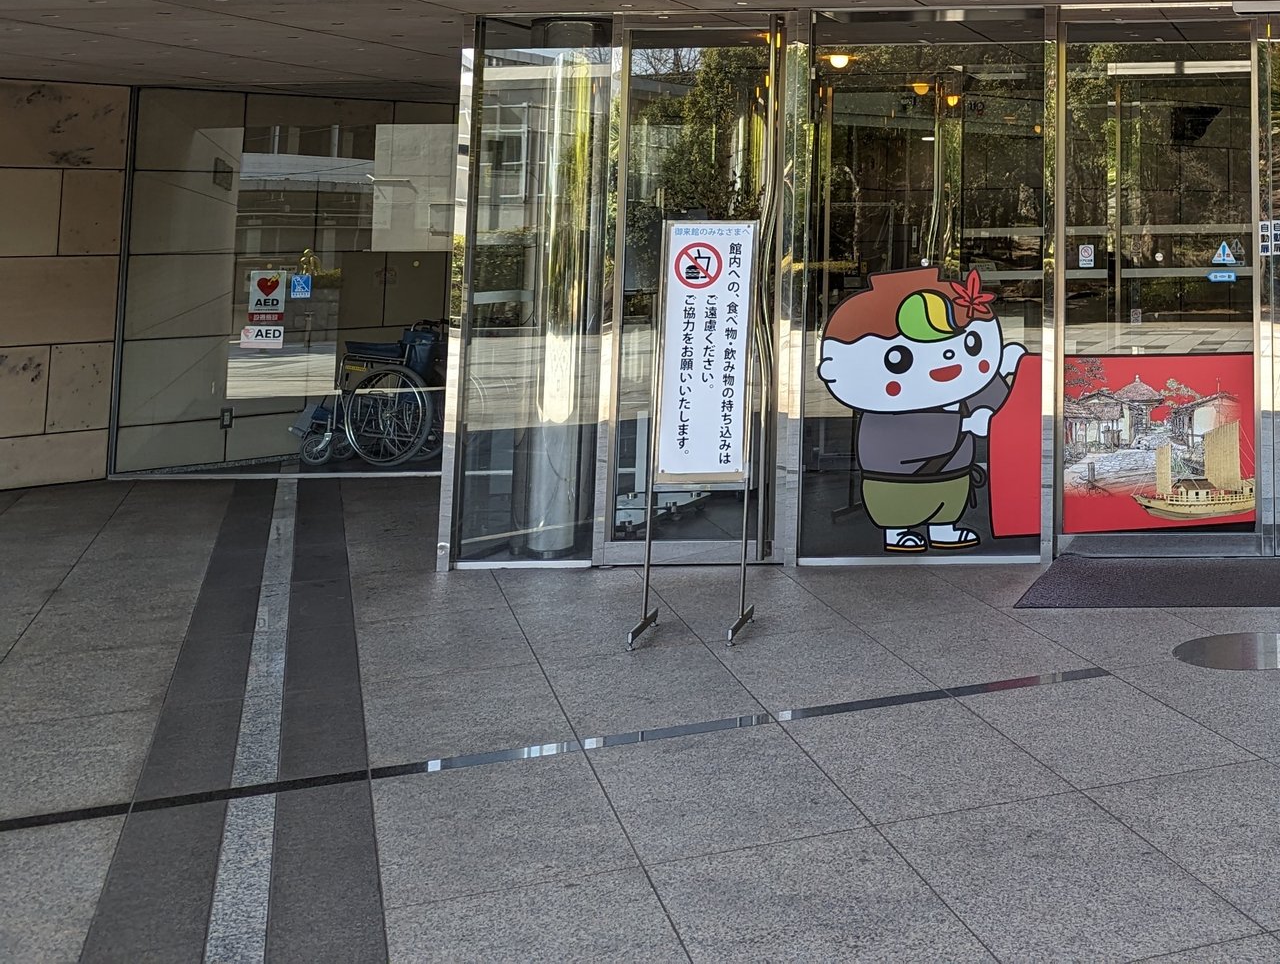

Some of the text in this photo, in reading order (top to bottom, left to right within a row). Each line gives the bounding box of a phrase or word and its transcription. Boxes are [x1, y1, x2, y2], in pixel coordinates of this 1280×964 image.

[674, 227, 750, 236] 御来館のみなさまへ
[255, 298, 279, 307] AED
[255, 329, 282, 339] AED
[701, 294, 718, 389] ご遠慮ください。
[718, 242, 742, 465] 館内への、食べ物・飲み物の持ち込みは
[676, 294, 696, 455] ご協力をお願いいたします。
